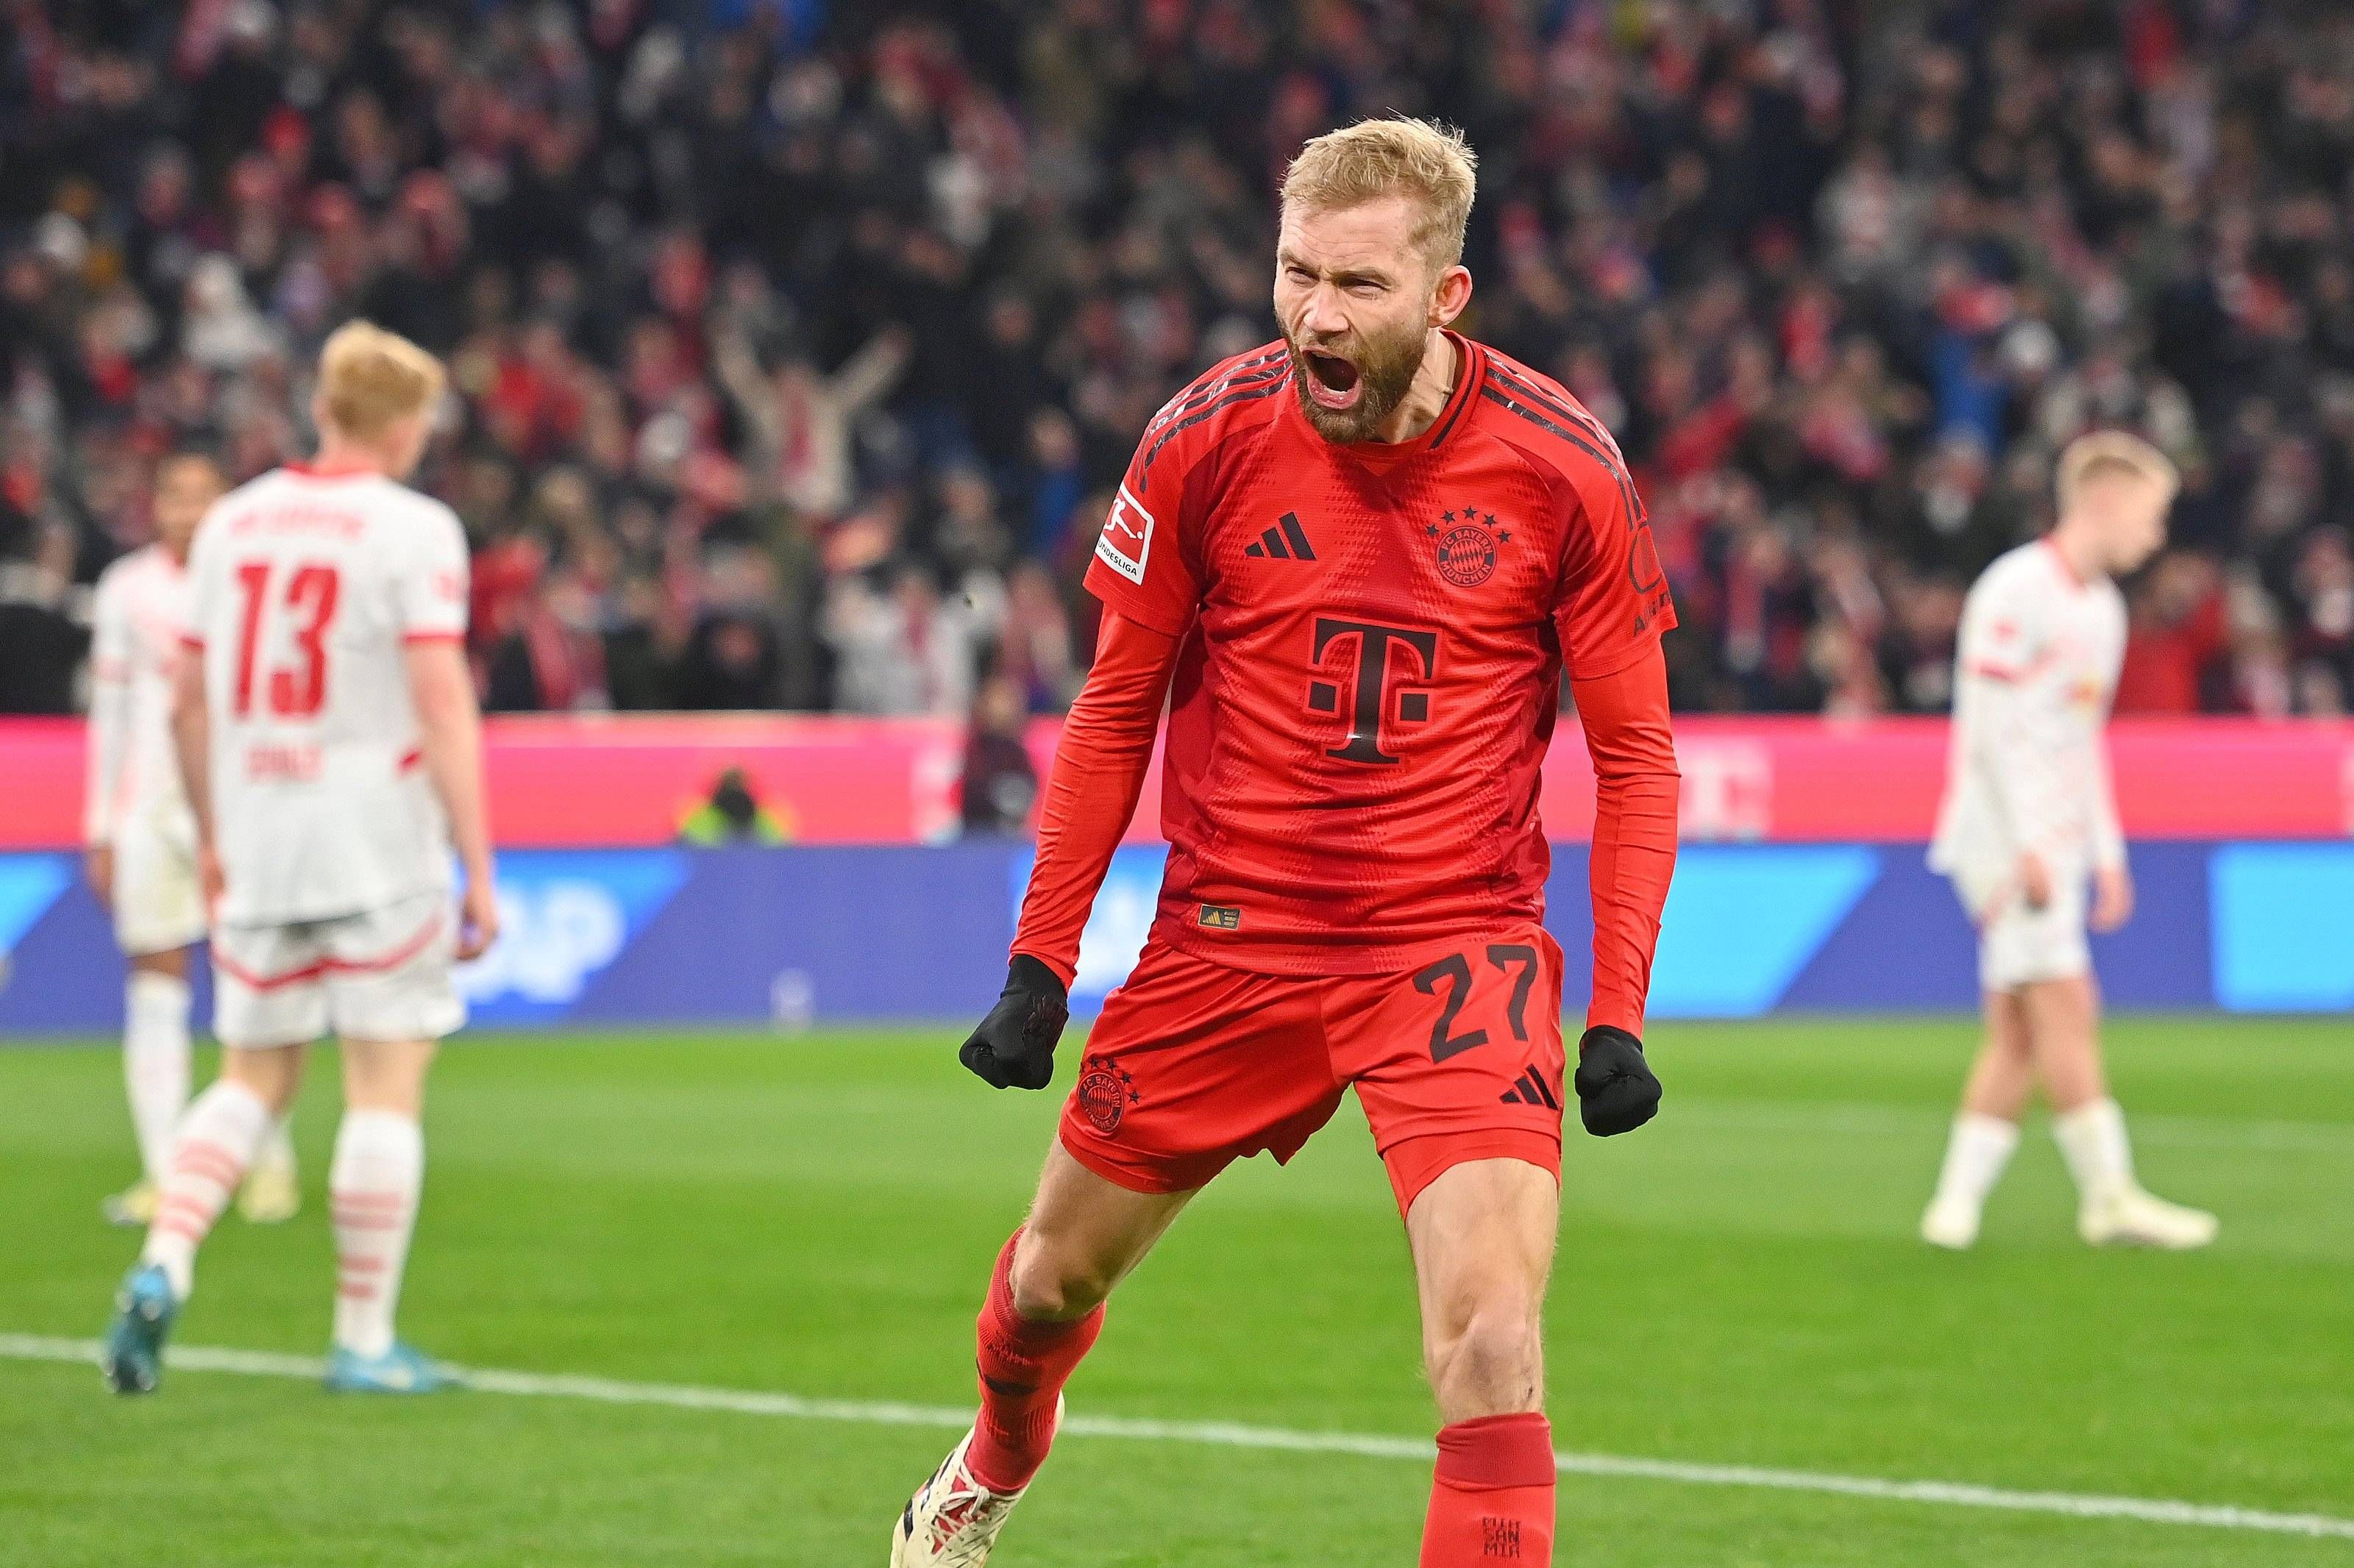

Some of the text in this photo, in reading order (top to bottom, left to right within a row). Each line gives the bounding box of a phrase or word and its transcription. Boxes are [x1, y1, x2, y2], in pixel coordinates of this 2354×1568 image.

[1098, 539, 1137, 576] UNDESLIGA
[1442, 530, 1493, 554] FC BAYERN
[237, 563, 340, 719] 13
[1309, 617, 1437, 764] T
[1412, 944, 1537, 1064] 27
[1095, 1076, 1121, 1108] BAYERN
